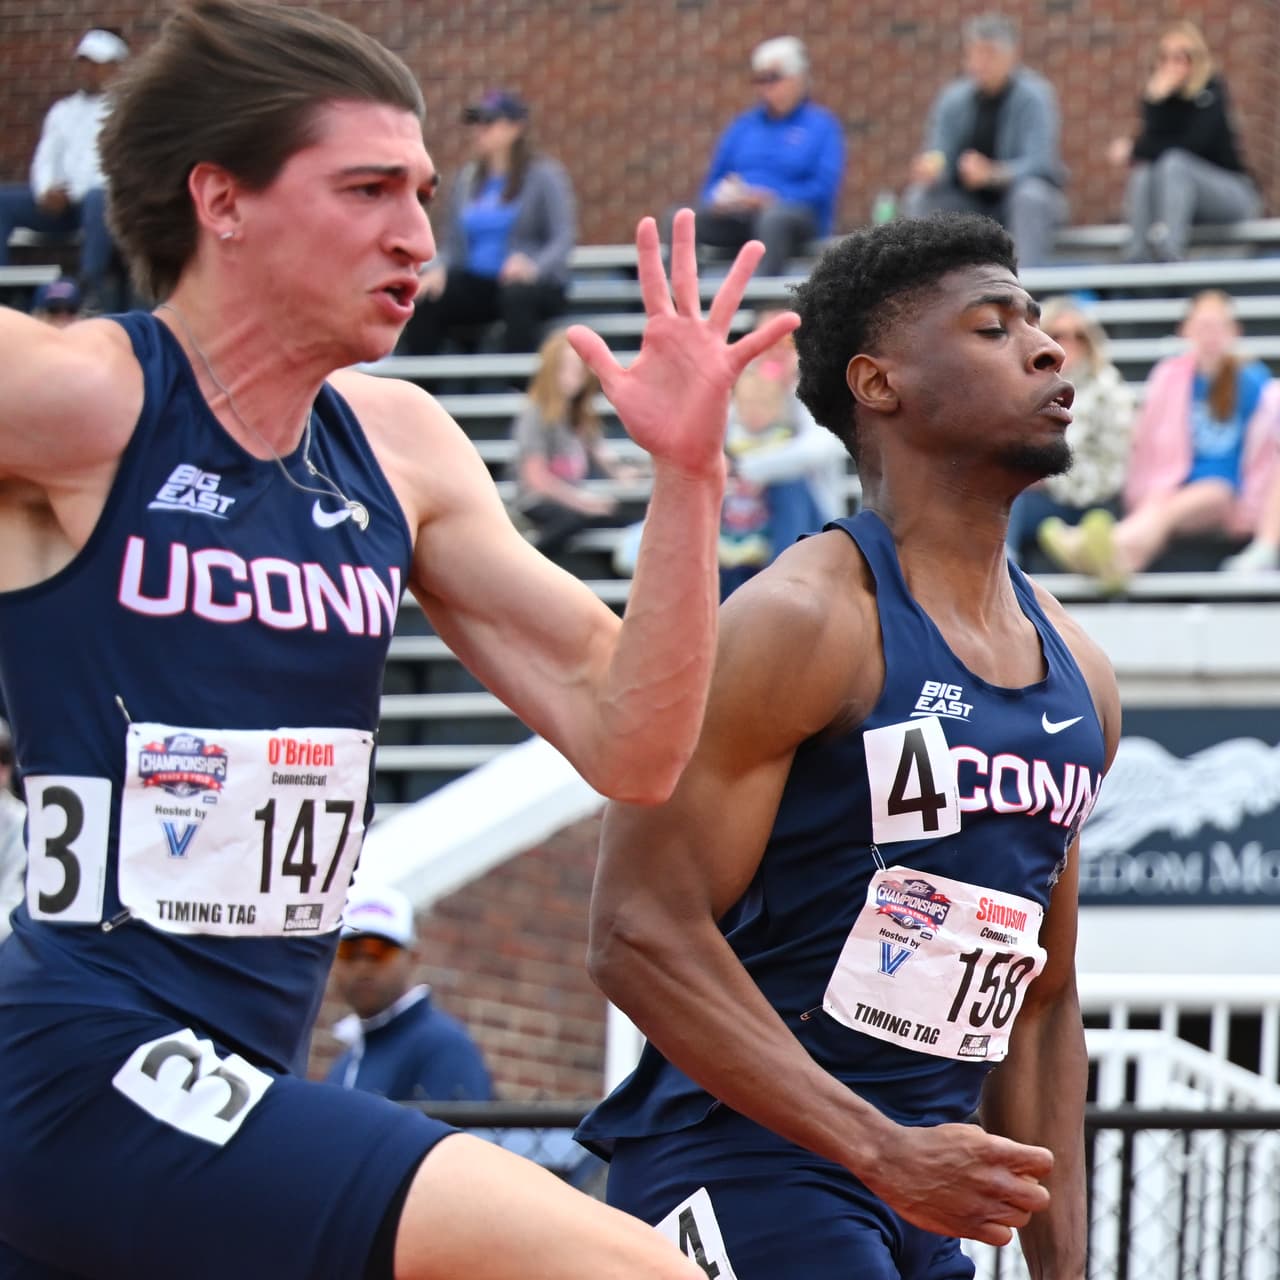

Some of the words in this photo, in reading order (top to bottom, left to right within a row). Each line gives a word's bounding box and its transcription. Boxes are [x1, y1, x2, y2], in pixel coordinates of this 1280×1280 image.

[167, 464, 221, 492] BIG
[156, 485, 235, 514] EAST
[118, 536, 401, 636] UCONN
[914, 697, 973, 718] EAST
[921, 680, 962, 701] BIG
[139, 752, 226, 778] CHAMPIONSHIPS
[268, 737, 334, 766] O'Brien
[271, 771, 327, 786] Connecticut
[888, 728, 947, 832] 4
[949, 745, 1102, 828] CONN
[155, 805, 191, 817] Hosted
[195, 808, 207, 820] by
[39, 785, 84, 914] 3
[163, 822, 199, 857] V
[254, 798, 355, 893] 147
[1079, 850, 1203, 895] EDOM
[157, 900, 222, 923] TIMING
[228, 904, 256, 925] TAG
[877, 887, 947, 920] CHAMPIONSHIPS
[976, 897, 1028, 932] Simpson
[879, 928, 908, 944] Hosted
[909, 937, 920, 949] by
[876, 939, 913, 978] V
[947, 947, 1035, 1029] 158
[854, 1003, 912, 1037] TIMING
[913, 1024, 940, 1045] TAG
[140, 1040, 251, 1122] 3
